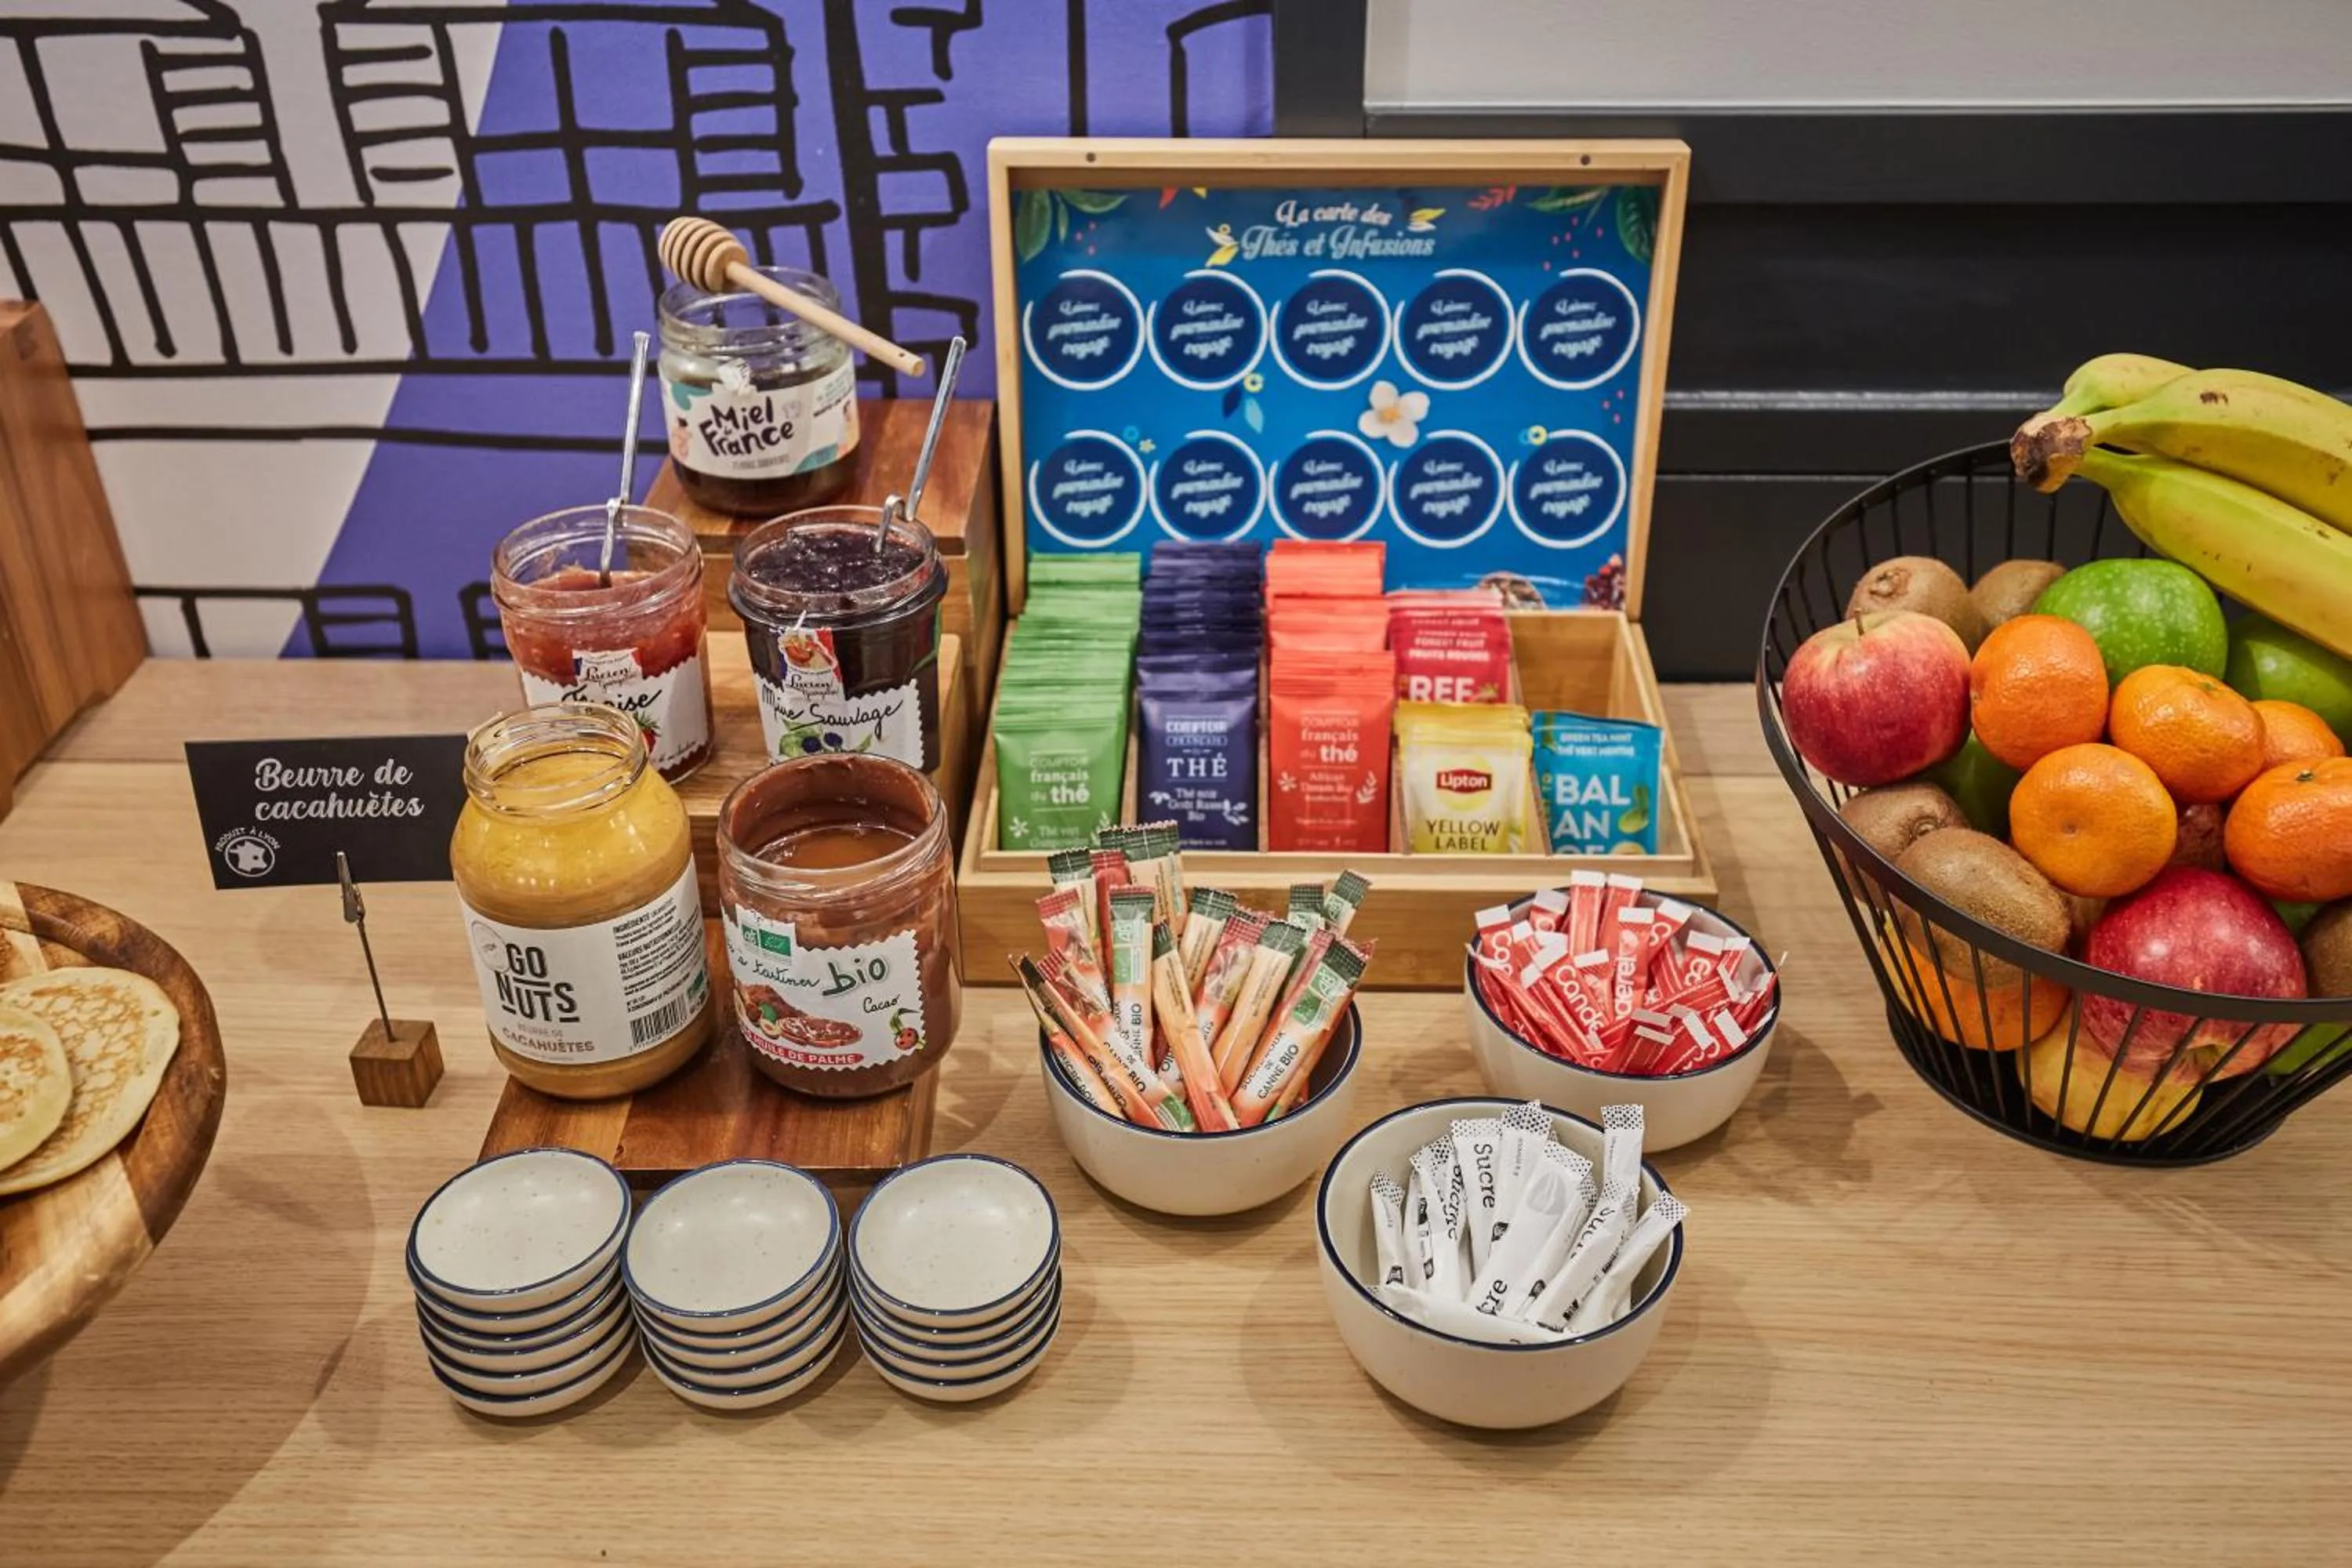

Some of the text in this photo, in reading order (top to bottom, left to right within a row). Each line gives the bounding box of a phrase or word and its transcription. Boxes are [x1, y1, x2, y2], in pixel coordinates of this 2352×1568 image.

[1276, 200, 1392, 227] La carte des
[1241, 225, 1435, 260] Thés et Infusions
[710, 396, 774, 431] Miel
[698, 420, 794, 457] France
[790, 700, 904, 741] Sauvage
[1301, 728, 1359, 744] français
[1166, 752, 1228, 777] THÉ
[1319, 743, 1359, 763] thé
[254, 757, 413, 792] Beurre de
[1030, 768, 1090, 785] français
[1440, 772, 1488, 789] Lipton
[1555, 773, 1632, 806] BAL
[254, 790, 426, 822] cacahuètes
[1051, 782, 1091, 804] thé
[1426, 818, 1501, 837] YELLOW
[1552, 808, 1611, 840] AN
[1435, 835, 1489, 852] LABEL
[506, 943, 548, 979] GO
[822, 957, 887, 996] bio
[495, 970, 577, 1022] NUTS
[863, 994, 900, 1014] Cacao
[1131, 1003, 1142, 1025] BIO
[788, 1050, 805, 1062] DE
[808, 1054, 856, 1065] PALME
[1258, 1044, 1299, 1099] CANNE BIO
[1474, 1144, 1495, 1208] Sucre
